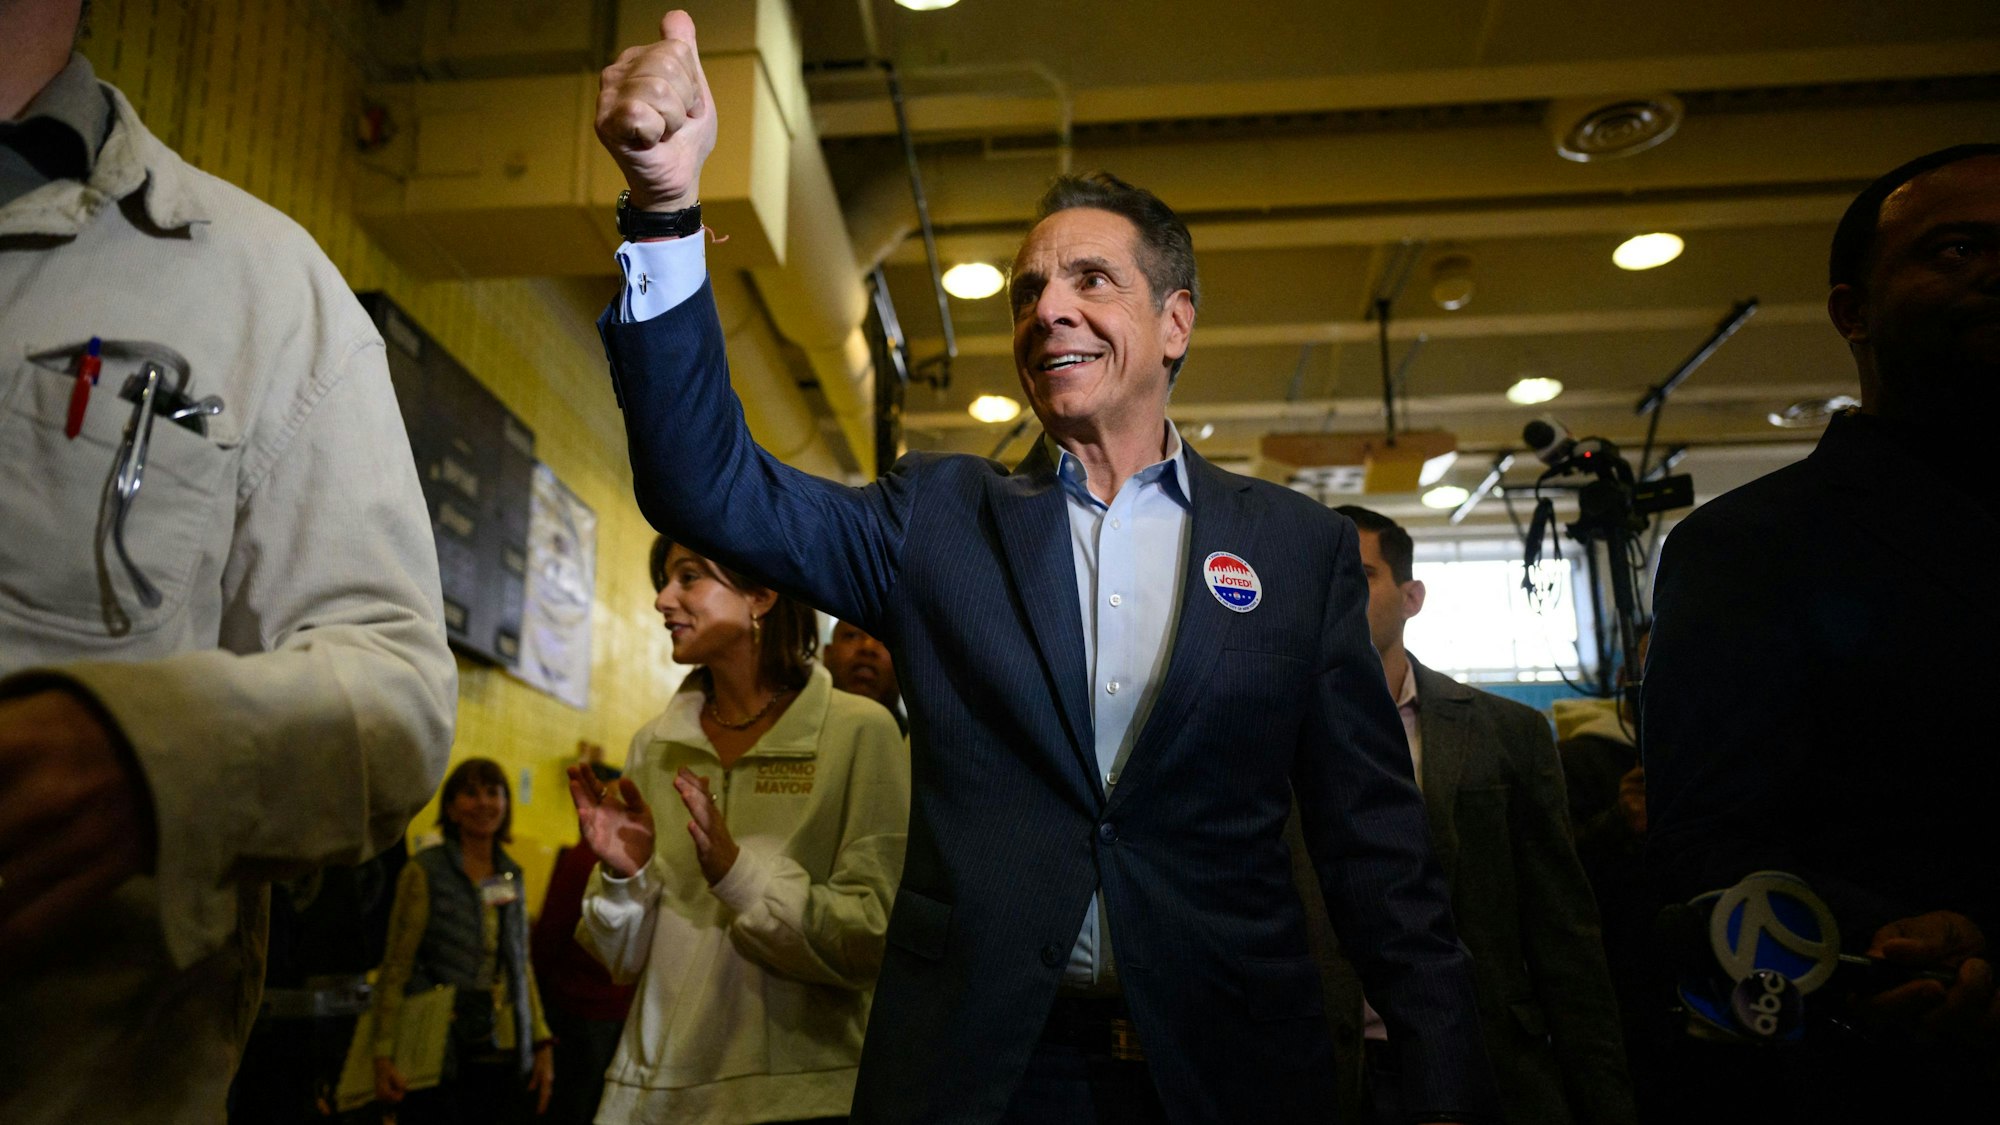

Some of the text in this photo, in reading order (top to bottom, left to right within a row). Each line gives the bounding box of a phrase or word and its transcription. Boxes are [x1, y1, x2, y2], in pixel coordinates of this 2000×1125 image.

[1219, 574, 1253, 588] VOTED!
[757, 762, 816, 776] CUOMO
[754, 781, 813, 794] MAYOR
[1749, 972, 1787, 1036] abc
